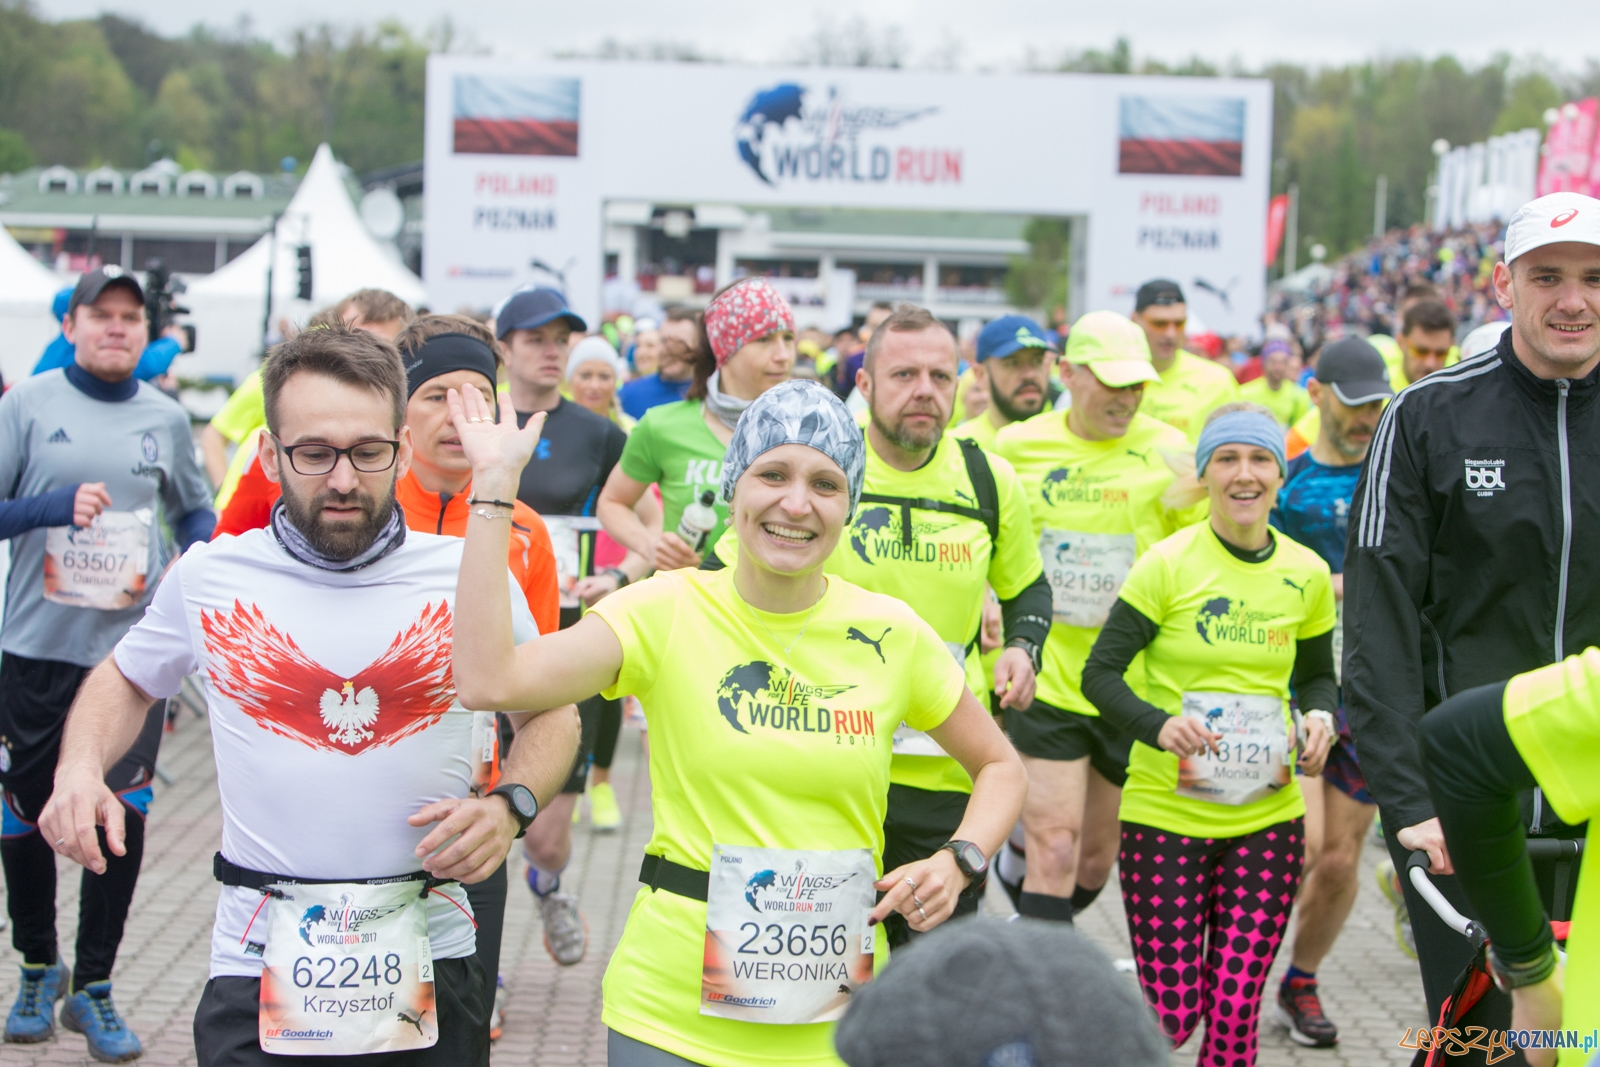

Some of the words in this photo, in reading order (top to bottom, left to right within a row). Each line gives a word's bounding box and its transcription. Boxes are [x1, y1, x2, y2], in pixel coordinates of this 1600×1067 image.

[774, 146, 890, 181] WORLD
[897, 148, 963, 183] RUN
[476, 174, 556, 196] POLAND
[1141, 194, 1220, 216] POLAND
[1465, 467, 1506, 489] bbl
[1057, 488, 1101, 502] WORLD
[1103, 488, 1129, 503] RUN
[874, 537, 936, 562] WORLD
[939, 543, 972, 563] RUN
[63, 550, 128, 573] 63507
[72, 572, 117, 586] Dariusz
[1052, 569, 1115, 592] 82136
[1216, 623, 1266, 644] WORLD
[1268, 629, 1290, 646] RUN
[771, 678, 824, 697] WINGS
[779, 692, 812, 706] LIFE
[748, 701, 831, 733] WORLD
[834, 710, 875, 737] RUN
[1214, 766, 1260, 779] Monika
[720, 855, 742, 864] POLAND
[780, 873, 833, 888] WINGS
[786, 888, 818, 900] LIFE
[329, 906, 379, 921] WINGS
[764, 900, 795, 912] WORLD
[796, 902, 813, 912] RUN
[815, 902, 833, 912] 2017
[336, 921, 363, 933] LIFE
[317, 934, 344, 945] WORLD
[344, 934, 360, 944] RUN
[361, 932, 377, 943] 2017
[737, 922, 847, 956] 23656
[864, 936, 872, 950] 2
[292, 953, 402, 989] 62248
[422, 964, 430, 978] 2
[733, 960, 849, 981] WERONIKA
[303, 992, 395, 1018] Krzysztof
[707, 992, 777, 1006] BFGoodrich
[266, 1028, 333, 1038] BFGoodrich
